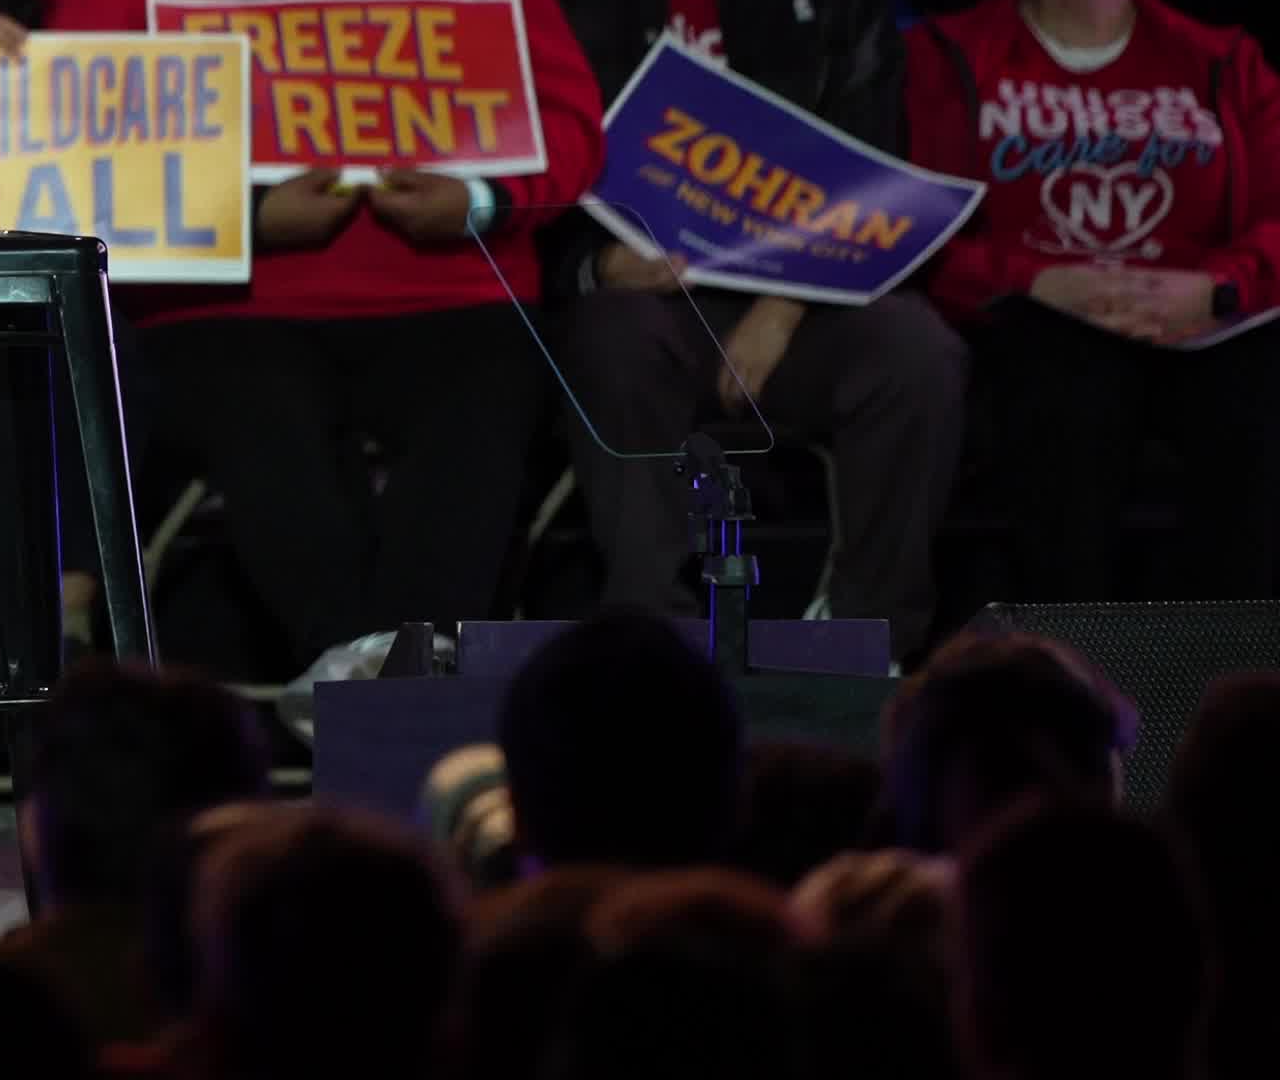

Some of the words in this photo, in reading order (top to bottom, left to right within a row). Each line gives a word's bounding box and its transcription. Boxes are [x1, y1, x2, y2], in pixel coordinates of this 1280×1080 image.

[272, 80, 512, 157] RENT
[12, 151, 218, 248] ALL
[647, 105, 915, 253] ZOHRAN
[1068, 181, 1157, 232] NY
